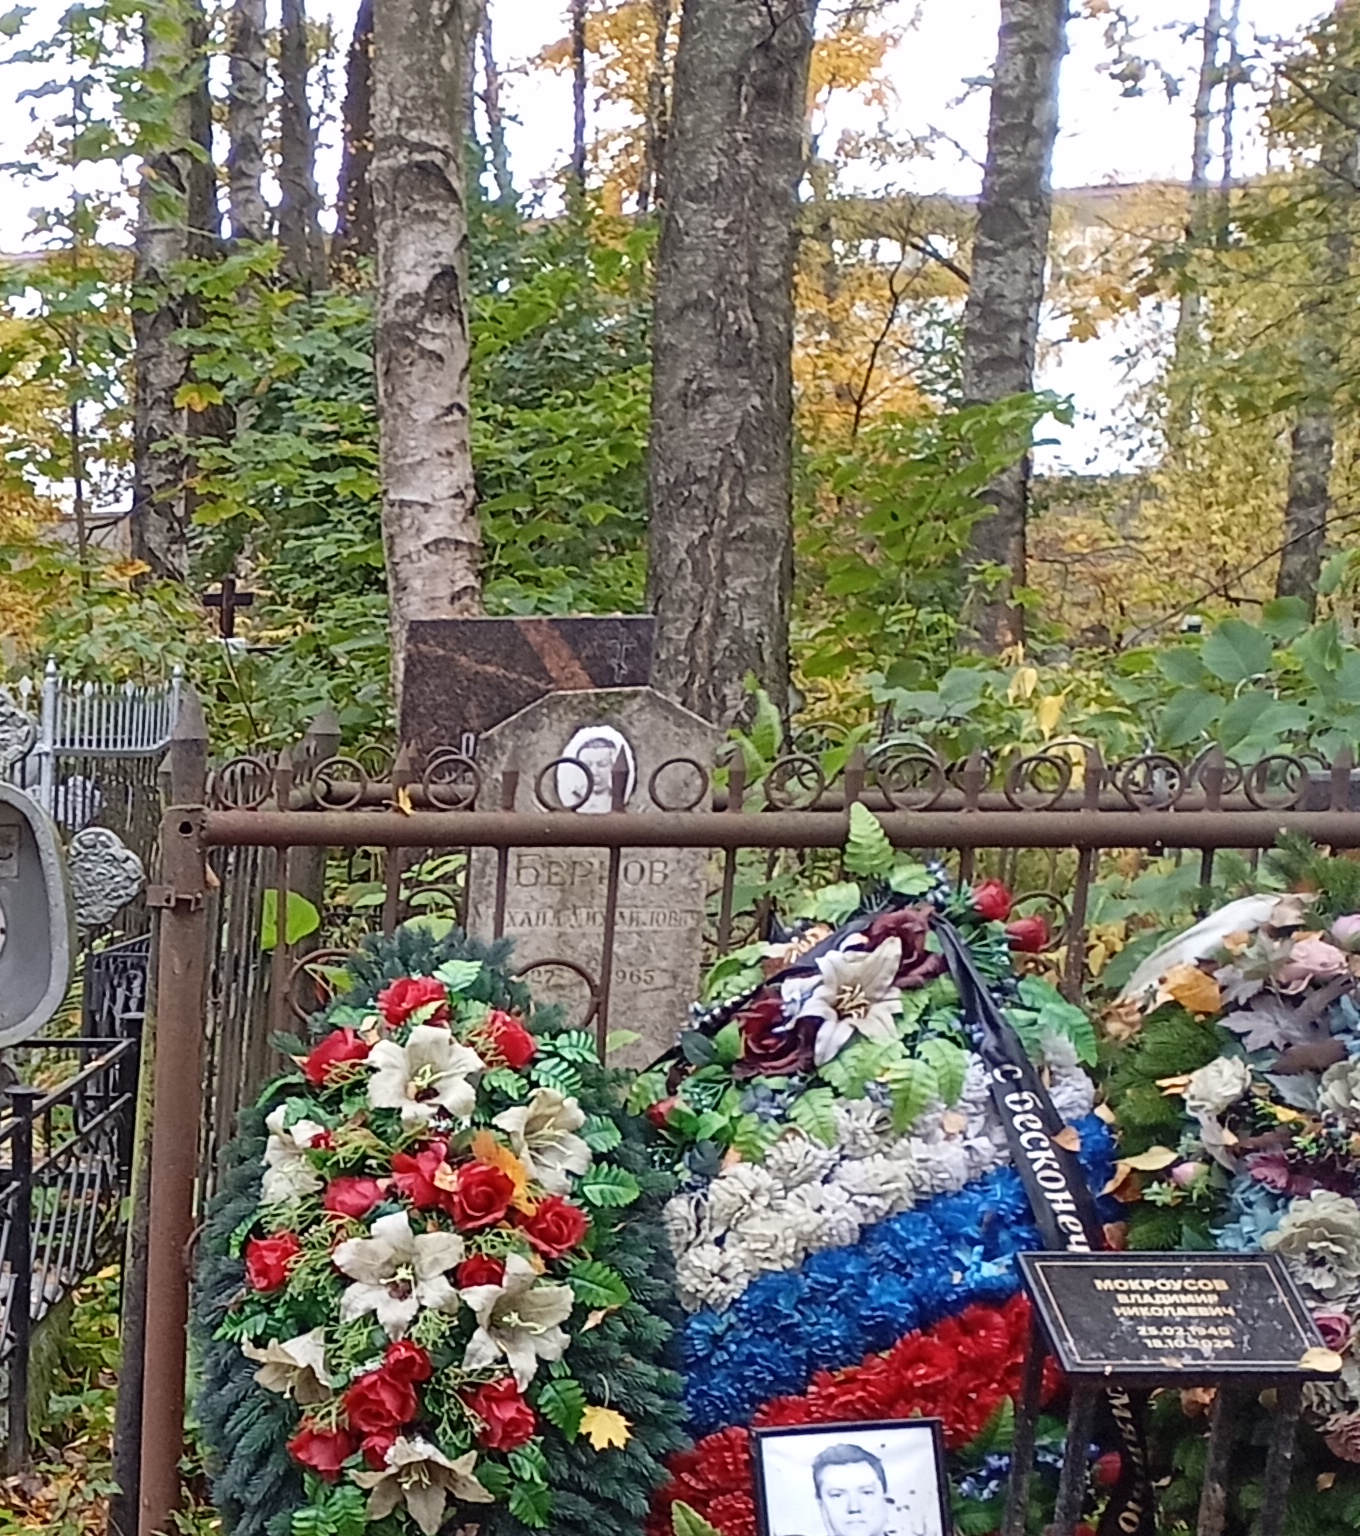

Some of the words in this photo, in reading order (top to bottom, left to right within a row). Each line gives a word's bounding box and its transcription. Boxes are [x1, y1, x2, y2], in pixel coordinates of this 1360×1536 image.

[614, 969, 656, 985] 965
[1093, 1278, 1230, 1291] МОКРОУСОВ
[1116, 1293, 1220, 1305] ВЛАДИМИР
[1112, 1305, 1236, 1317] НИКОЛАЕВИЧ
